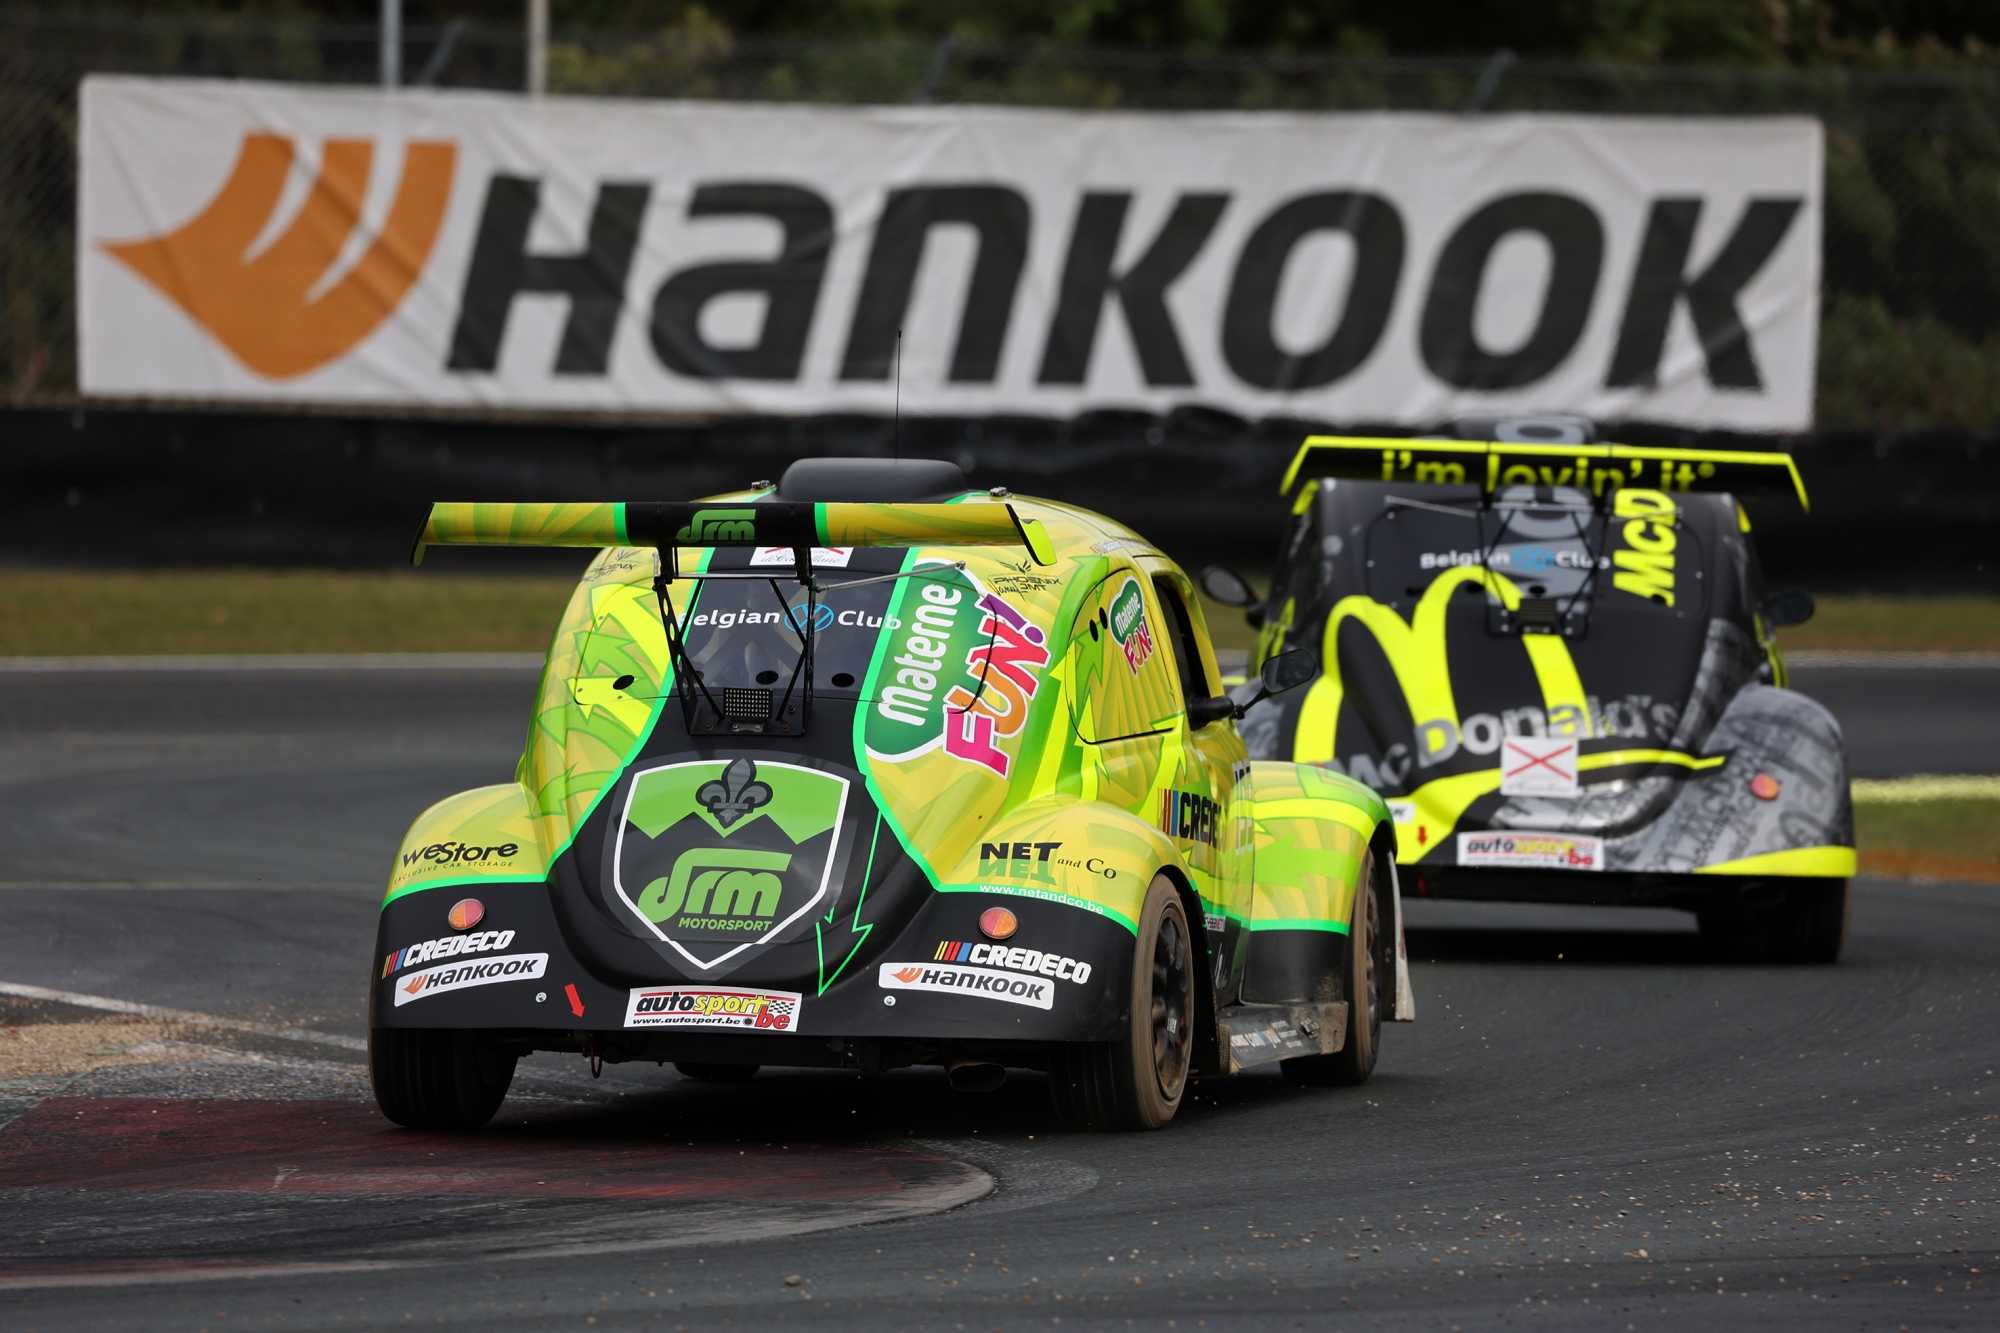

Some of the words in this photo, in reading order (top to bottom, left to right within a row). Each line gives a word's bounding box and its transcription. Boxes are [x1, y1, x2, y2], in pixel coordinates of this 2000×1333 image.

[1420, 548, 1510, 570] Belgian
[677, 609, 781, 628] Belgian
[838, 610, 902, 630] Club
[1123, 614, 1153, 678] FUN!
[942, 593, 1052, 780] FUN!
[980, 842, 1063, 862] NET
[1057, 856, 1082, 869] and
[1086, 858, 1117, 879] Co
[393, 865, 438, 885] EXCLUSIVE
[979, 884, 1104, 915] www.netandco.be
[678, 917, 773, 932] MOTORSPORT
[402, 930, 516, 968] CREDECO
[968, 943, 1092, 984] CREDECO
[636, 991, 771, 1017] autosport
[632, 1016, 741, 1026] www.autosport.be
